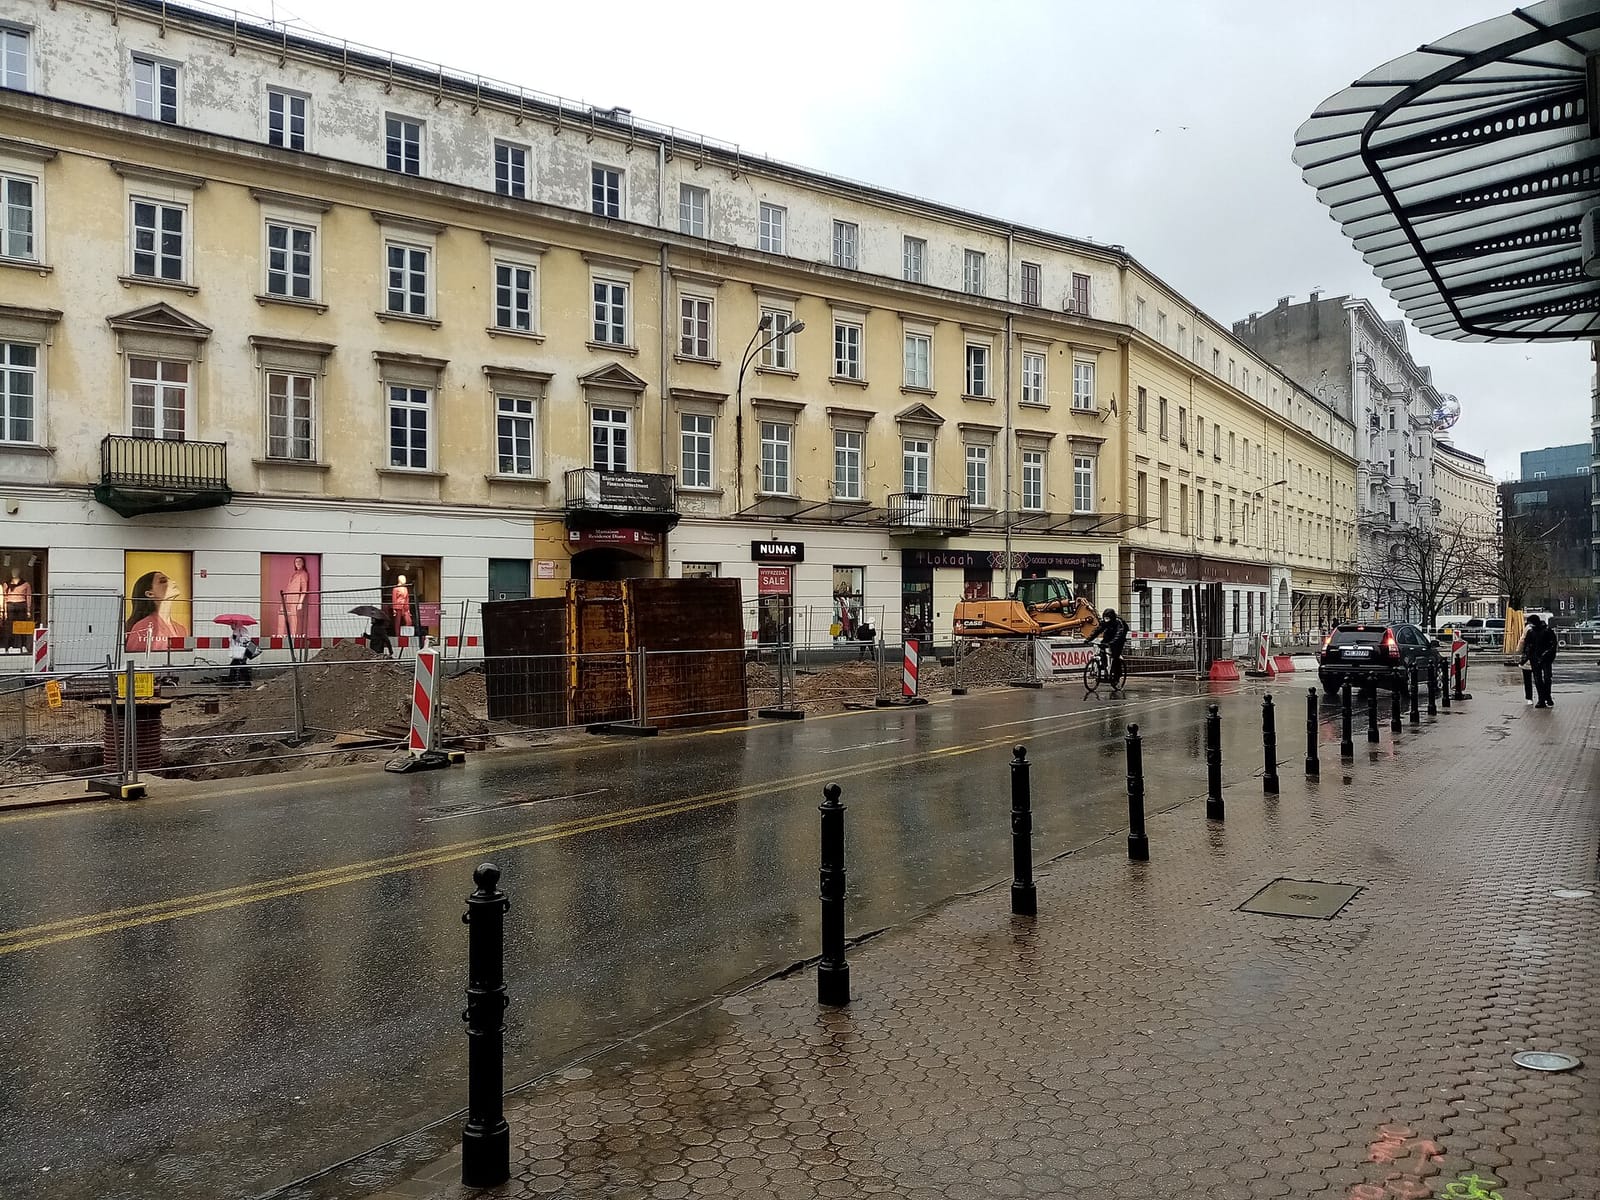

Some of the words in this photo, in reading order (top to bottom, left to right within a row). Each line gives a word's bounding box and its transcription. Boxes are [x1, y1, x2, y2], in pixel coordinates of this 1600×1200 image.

[760, 544, 797, 555] NUNAR
[927, 553, 974, 566] Lokaah
[1031, 557, 1047, 565] GOODS
[1064, 558, 1080, 566] WORLD
[762, 577, 785, 586] SALE
